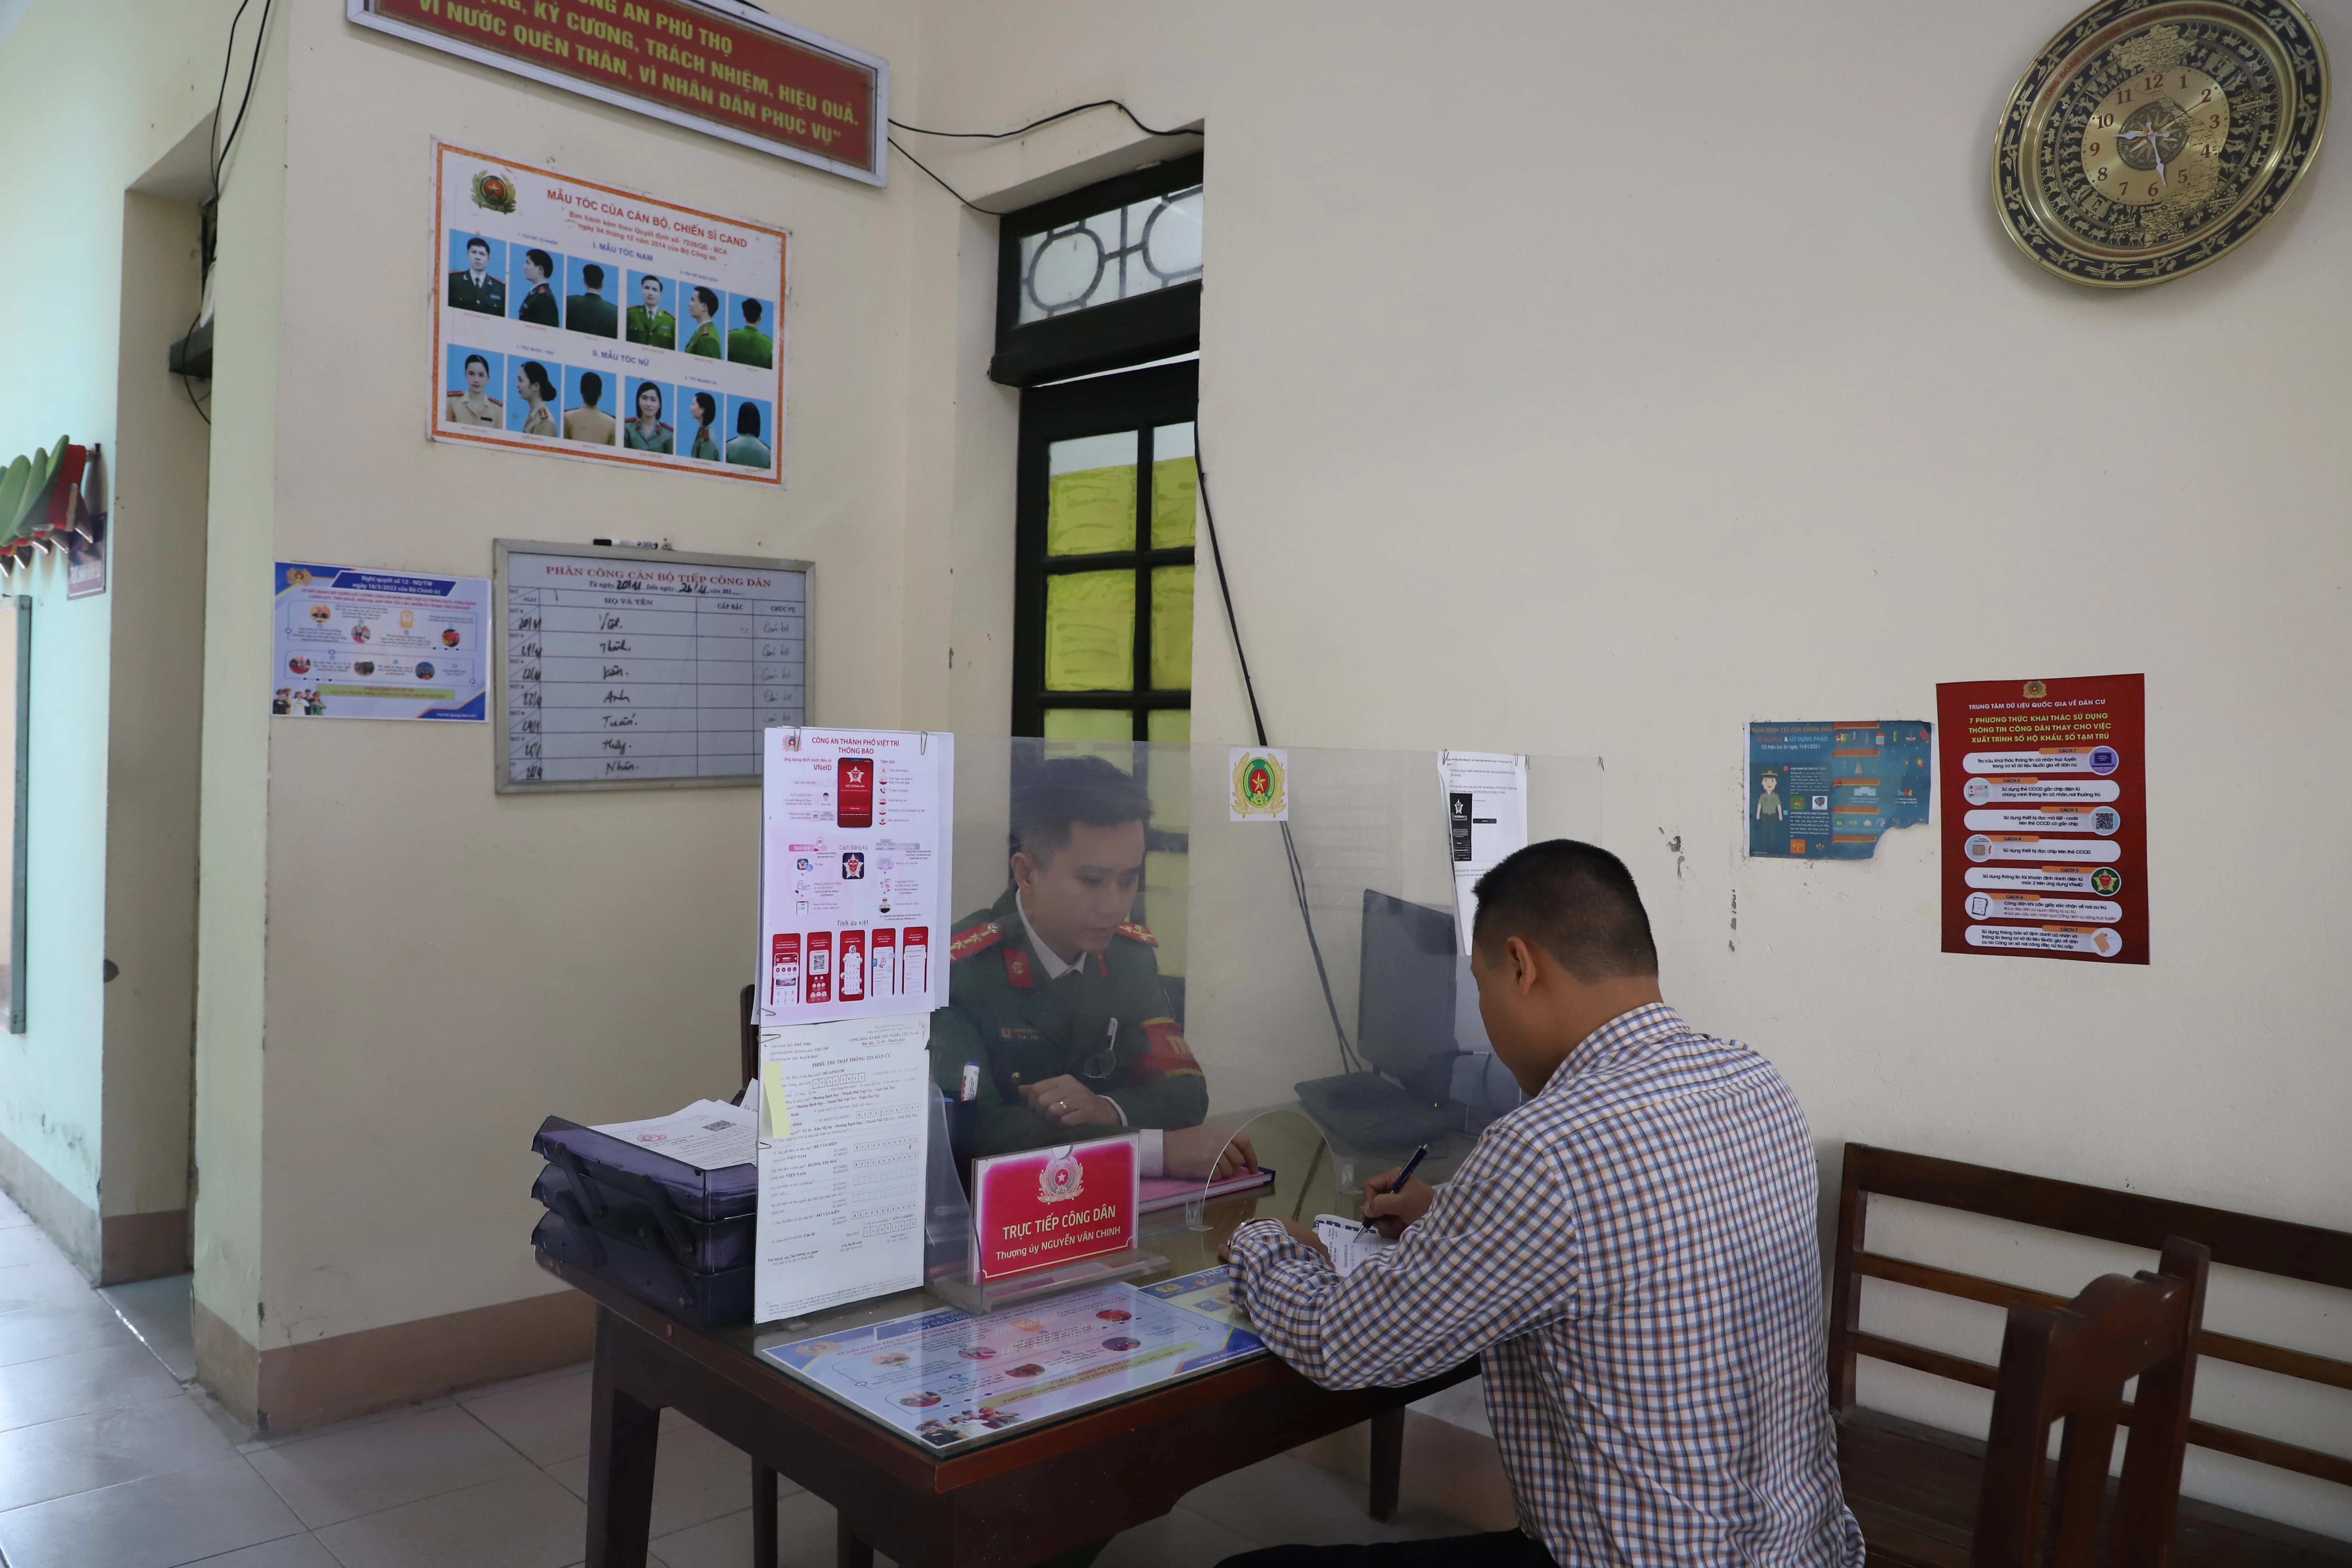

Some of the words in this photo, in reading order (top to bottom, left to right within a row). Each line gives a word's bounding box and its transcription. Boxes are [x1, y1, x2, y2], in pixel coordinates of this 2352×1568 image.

[623, 2, 649, 25] AN
[656, 12, 693, 39] PHÚ
[698, 28, 732, 57] THỌ
[447, 1, 506, 36] NƯỚC
[514, 24, 569, 58] QUÊN
[575, 44, 632, 80] THÂN,
[639, 65, 656, 86] VÌ
[662, 73, 713, 105] NHÂN
[719, 92, 756, 118] DÂN
[761, 106, 806, 135] PHỤC
[534, 1, 560, 23] KỶ
[567, 12, 639, 53] CƯƠNG,
[646, 38, 705, 74] TRÁCH
[711, 63, 774, 98] NHIỆM,
[779, 84, 817, 111] HIỆU
[822, 100, 859, 125] QUẢ.
[2144, 74, 2164, 90] 12
[2179, 75, 2188, 89] 1
[2116, 88, 2133, 105] 11
[2201, 88, 2212, 104] 2
[2096, 113, 2114, 129] 10
[2209, 114, 2220, 129] 3
[2089, 142, 2100, 157] 9
[2200, 144, 2211, 158] 4
[2097, 167, 2108, 181] 8
[2177, 169, 2188, 184] 5
[2119, 181, 2129, 196] 7
[2147, 182, 2159, 197] 6
[547, 189, 573, 204] MẪU
[577, 196, 598, 210] TÓC
[601, 203, 624, 218] CỦA
[627, 210, 649, 224] CÁN
[653, 216, 671, 231] BỘ,
[674, 222, 704, 237] CHIẾN
[719, 234, 747, 248] CAND
[599, 243, 616, 254] MẪU
[619, 248, 634, 257] TÓC
[636, 253, 654, 262] NAM
[601, 350, 619, 360] MẪU
[620, 354, 636, 364] TÓC
[638, 358, 650, 366] NỮ
[546, 566, 583, 576] PHÂN
[588, 568, 624, 579] CÔNG
[628, 570, 655, 580] CÁN
[658, 572, 675, 583] BỘ
[678, 571, 707, 584] TIẾP
[709, 575, 744, 586] CÔNG
[747, 577, 771, 588] DÂN
[2093, 722, 2112, 730] VIỆC
[2014, 733, 2024, 742] SỔ
[2026, 734, 2038, 743] HỘ
[2040, 733, 2064, 741] KHẨU,
[2065, 732, 2075, 741] SỔ
[1003, 1221, 1032, 1240] TRỰC
[1034, 1213, 1059, 1233] TIẾP
[1061, 1210, 1090, 1228] CÔNG
[1093, 1204, 1116, 1222] DÂN
[996, 1244, 1027, 1261] Thượng
[1029, 1243, 1039, 1255] úy
[1041, 1233, 1075, 1251] NGUYỄN
[1096, 1226, 1121, 1239] CHINH
